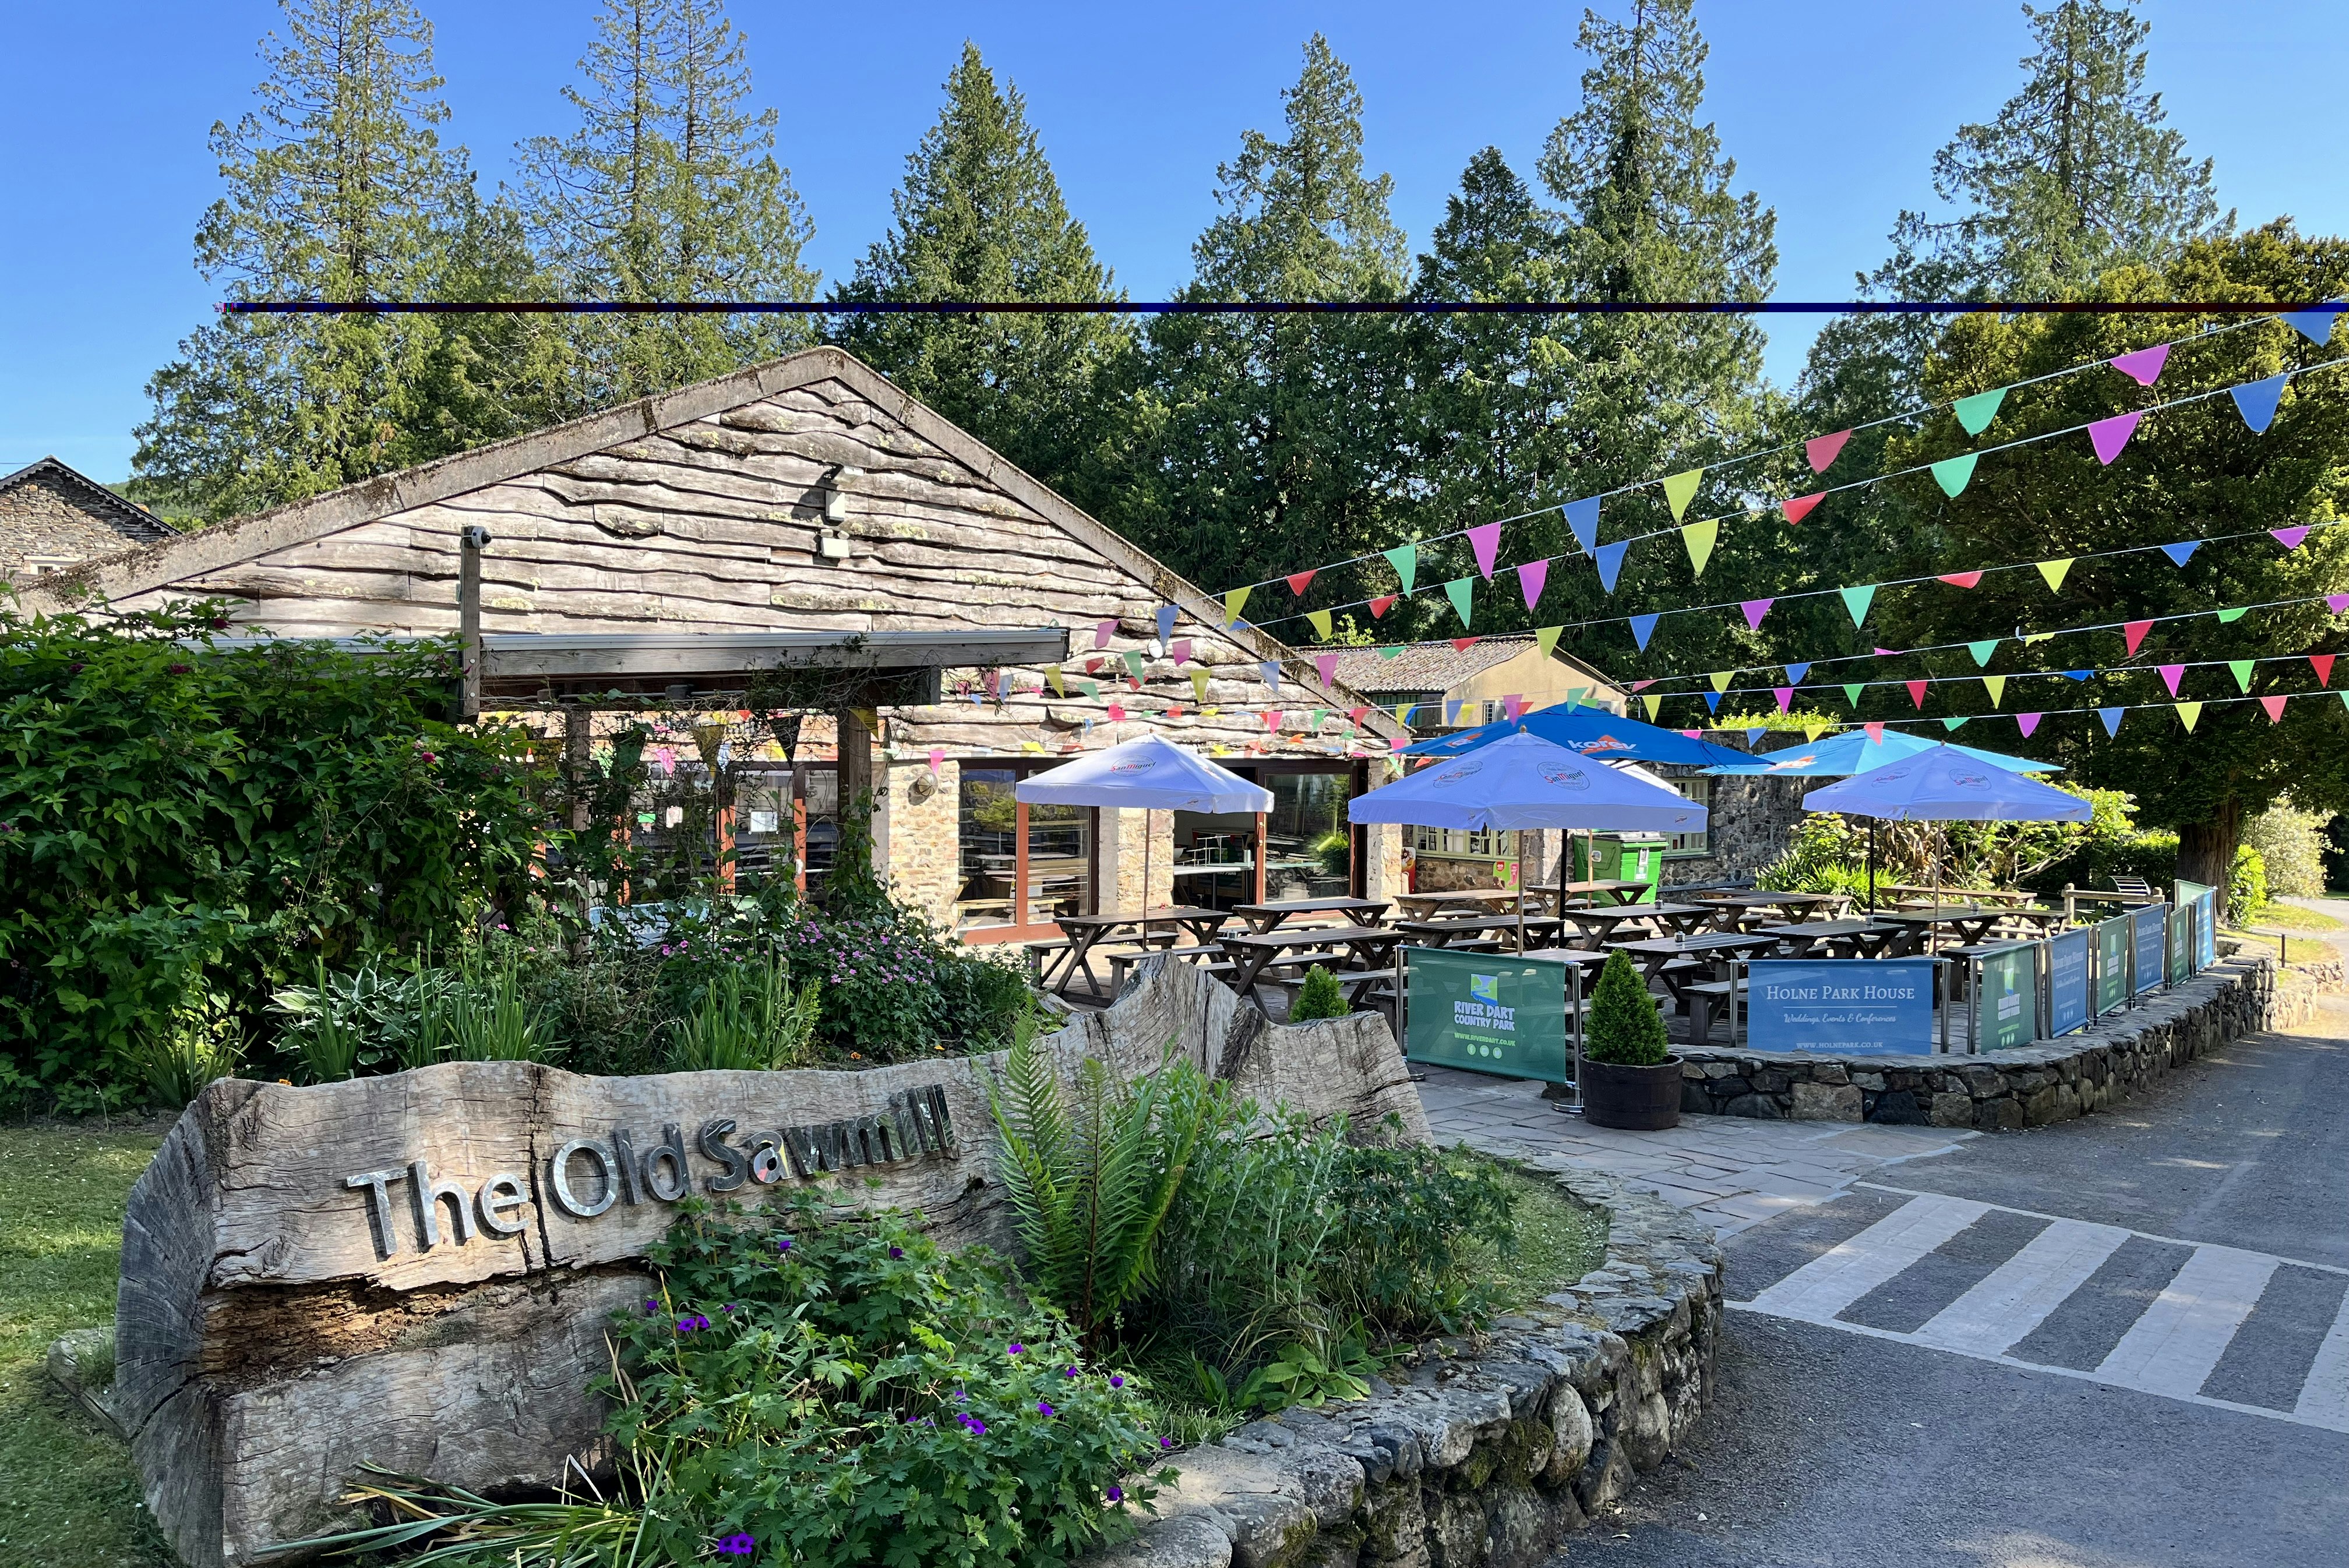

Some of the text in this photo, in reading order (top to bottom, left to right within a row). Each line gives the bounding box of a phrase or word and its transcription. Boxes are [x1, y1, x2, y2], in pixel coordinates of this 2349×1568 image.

[1567, 740, 1636, 750] korev
[1766, 986, 1915, 1000] HOLNE PARK HOUSE
[1454, 1001, 1515, 1020] RIVER DART
[1454, 1014, 1515, 1032] COUNTRY PARK
[1822, 1013, 1845, 1023] Events
[1847, 1013, 1854, 1022] &
[1856, 1013, 1896, 1024] Conferences
[1454, 1032, 1516, 1047] WWW.RIVERDART.CO.UK
[345, 1083, 957, 1257] The Old Sawmill
